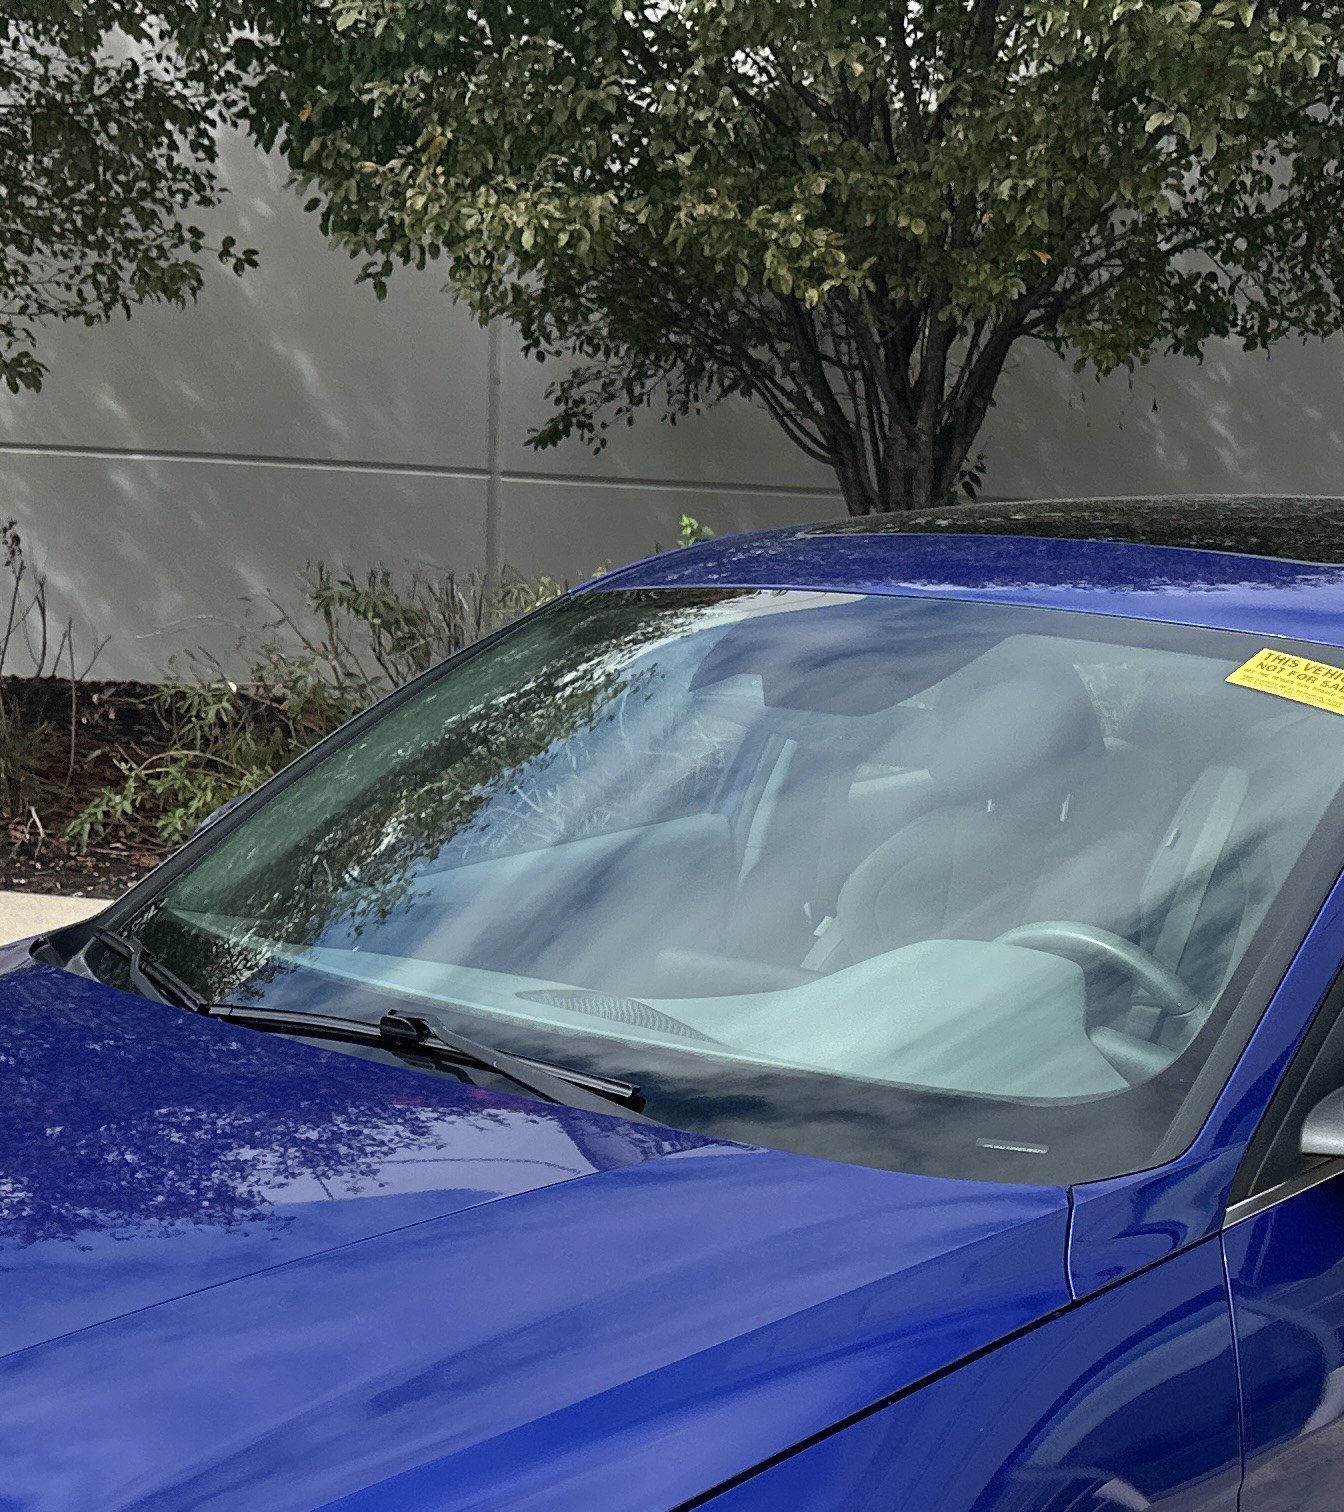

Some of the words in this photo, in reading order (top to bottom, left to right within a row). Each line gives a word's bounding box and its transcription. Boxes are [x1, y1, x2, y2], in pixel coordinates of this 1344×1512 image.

[1263, 652, 1299, 669] THIS
[1256, 661, 1286, 675] NOT
[1287, 670, 1316, 684] FOR
